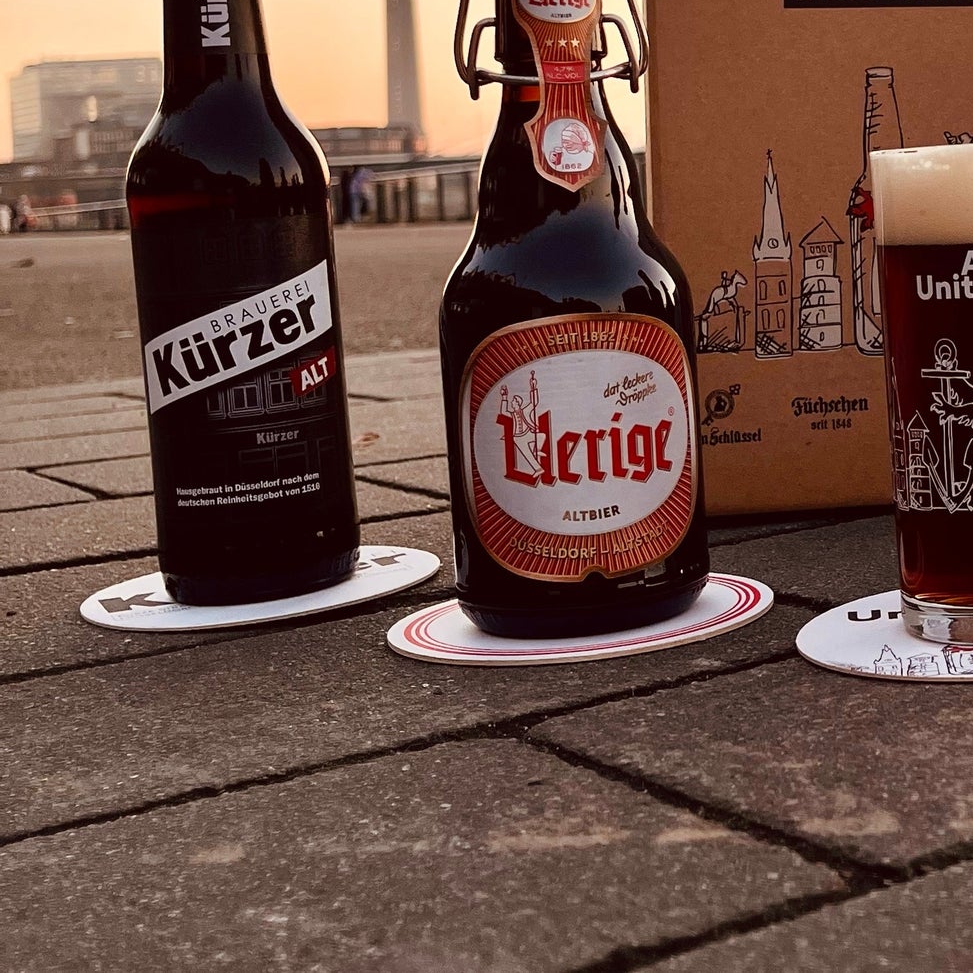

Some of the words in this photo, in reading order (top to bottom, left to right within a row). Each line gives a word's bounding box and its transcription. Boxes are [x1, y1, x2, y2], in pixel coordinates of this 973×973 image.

[561, 162, 582, 170] 1862
[210, 280, 310, 334] BRAUEREI
[152, 294, 316, 397] Kürzer
[548, 332, 578, 346] SEIT
[583, 331, 615, 343] 1862
[301, 356, 328, 391] ALT
[603, 382, 620, 398] dat
[791, 396, 869, 417] Füchschen
[811, 419, 828, 431] seit
[256, 430, 300, 445] Kürzer
[710, 427, 762, 446] Schlüssel
[496, 410, 674, 489] Uerige
[176, 485, 222, 496] Hausgebraut
[225, 484, 233, 493] in
[235, 478, 280, 492] Düsseldorf
[282, 475, 302, 485] nach
[303, 472, 320, 481] dem
[177, 498, 215, 507] deutschen
[216, 491, 283, 505] Reinheitsgebot
[285, 488, 300, 496] von
[562, 505, 621, 522] ALTBIER
[509, 536, 597, 560] DÜSSELDORF
[612, 519, 669, 555] ALTSTADT
